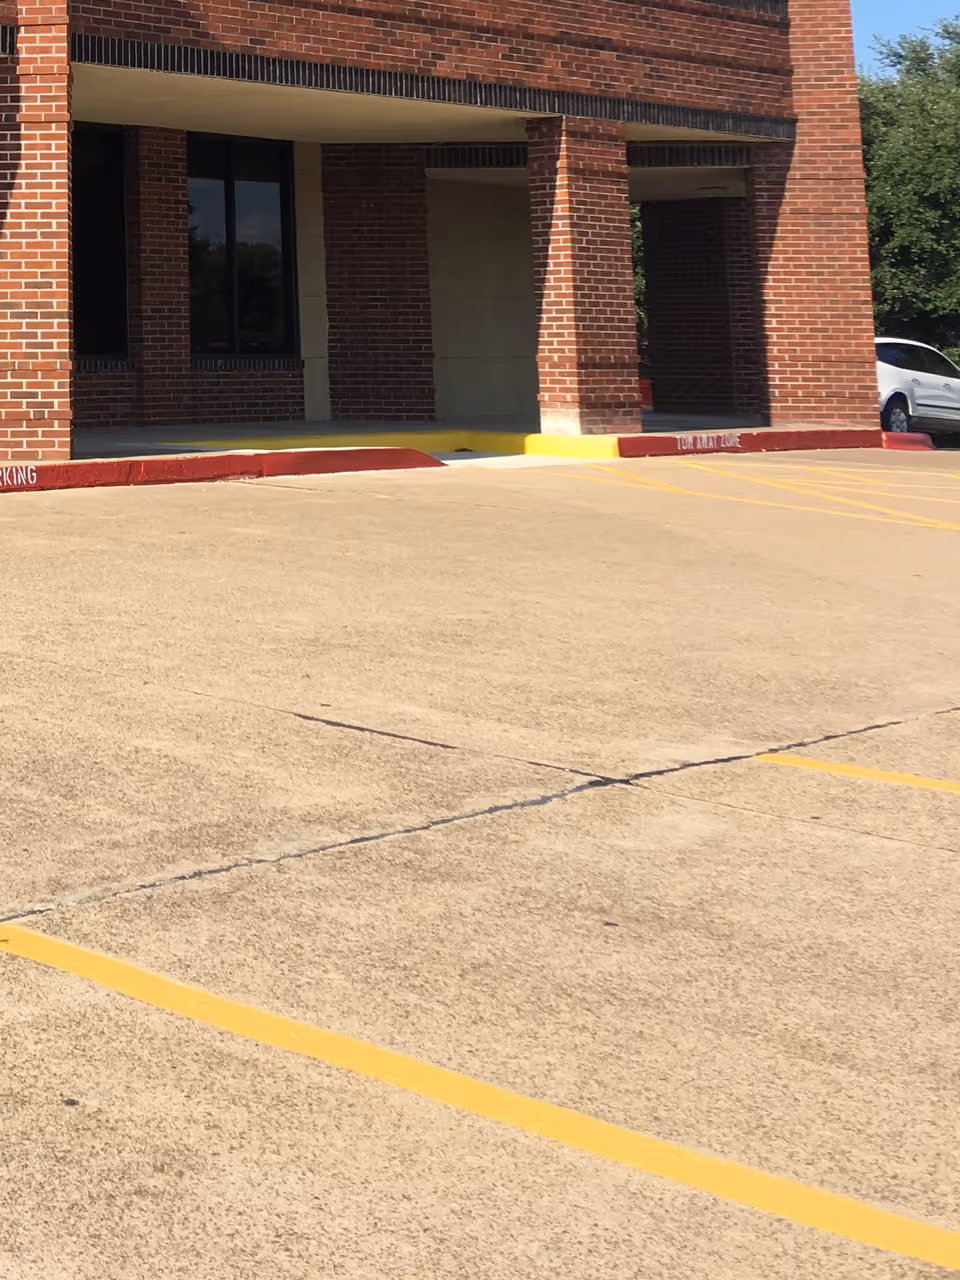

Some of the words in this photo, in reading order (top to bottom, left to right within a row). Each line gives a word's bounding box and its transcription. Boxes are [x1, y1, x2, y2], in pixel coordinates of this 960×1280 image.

[675, 435, 694, 450] TOW
[696, 434, 719, 449] AWAY
[721, 433, 742, 448] ZONE
